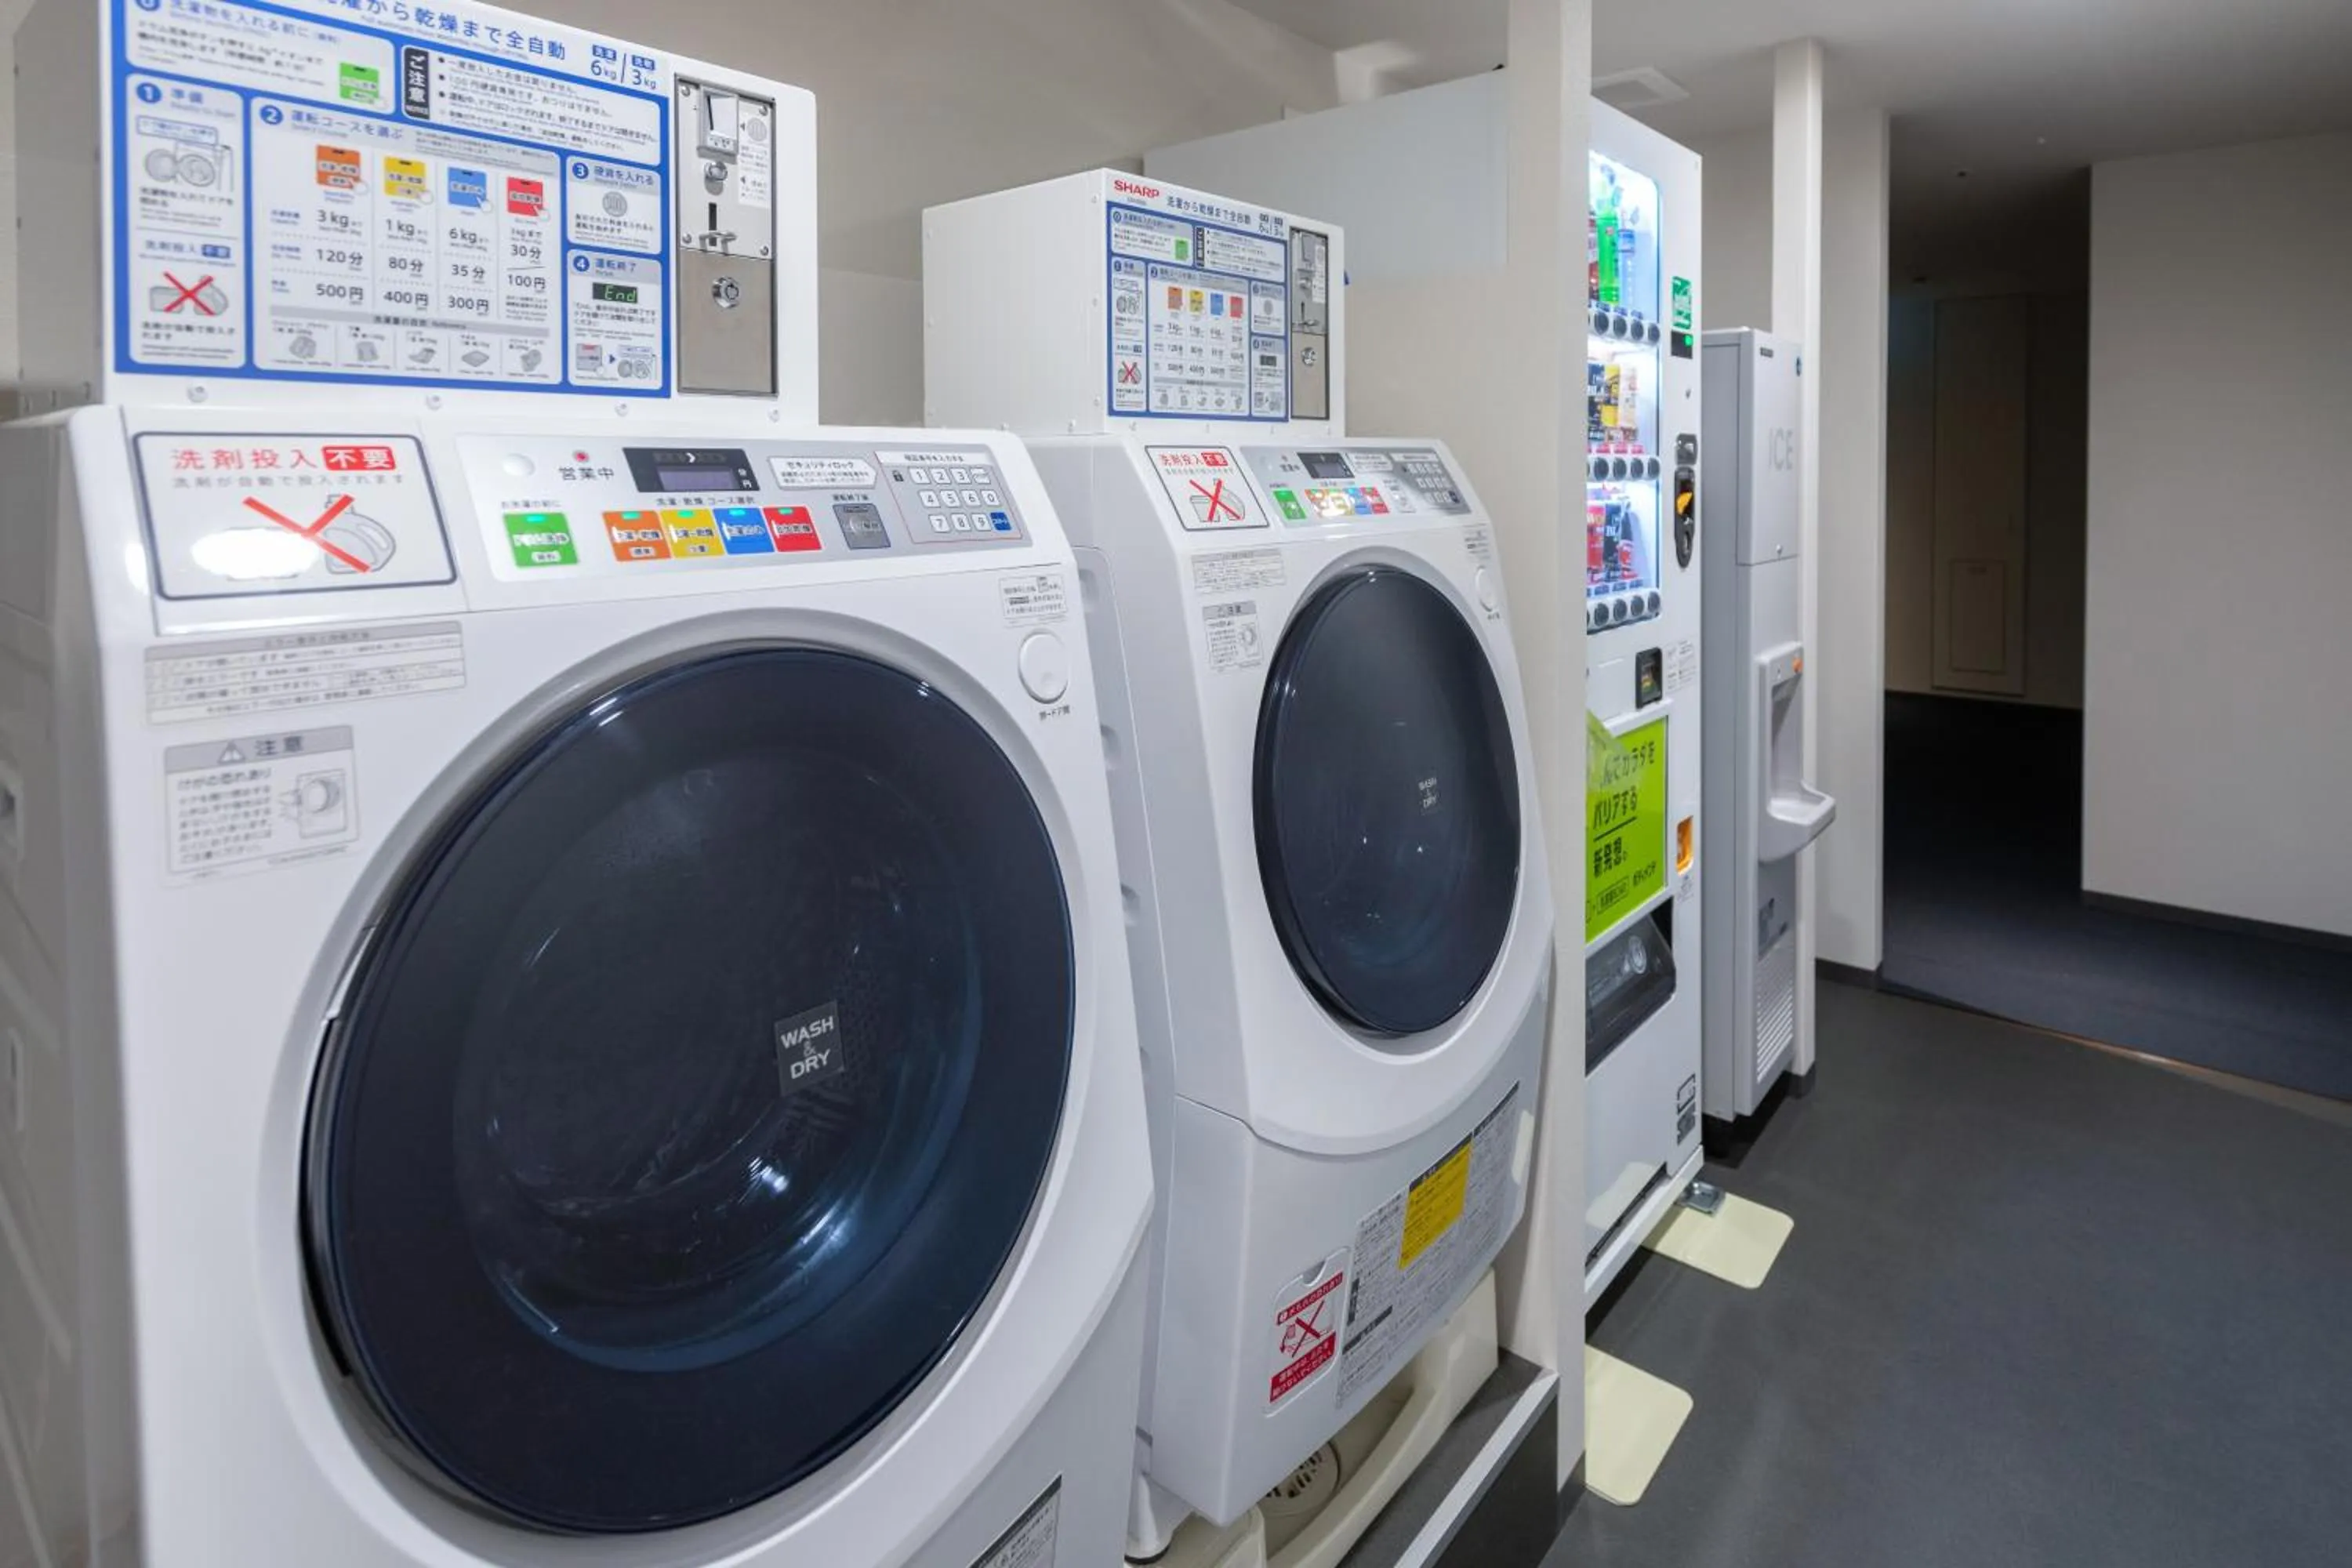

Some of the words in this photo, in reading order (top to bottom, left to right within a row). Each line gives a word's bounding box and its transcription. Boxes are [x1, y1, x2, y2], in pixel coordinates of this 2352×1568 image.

[327, 0, 565, 60] から乾燥まで全自動
[408, 56, 426, 103] ご注意
[292, 110, 403, 139] 運転コースを選ぶ
[593, 165, 654, 186] 硬貨を入れる
[1113, 180, 1160, 198] SHARP
[1167, 197, 1251, 225] 洗濯から乾燥まで全自動
[317, 249, 363, 266] 120分
[389, 257, 423, 273] 80分
[452, 264, 485, 279] 35分
[511, 245, 542, 260] 30分
[595, 259, 637, 274] 運転終了
[316, 283, 364, 301] 500円
[384, 291, 429, 307] 400円
[448, 296, 489, 312] 300円
[508, 274, 546, 290] 100円
[171, 448, 317, 470] 洗剤投入
[326, 448, 392, 470] 不要
[1769, 428, 1793, 470] ICE
[172, 474, 404, 489] 洗剤が自動で投入されます
[558, 467, 614, 481] 営業中
[255, 735, 303, 757] 注意
[1593, 786, 1638, 829] バリアする
[781, 1016, 834, 1049] WASH
[803, 1040, 816, 1057] &
[790, 1048, 831, 1080] DRY
